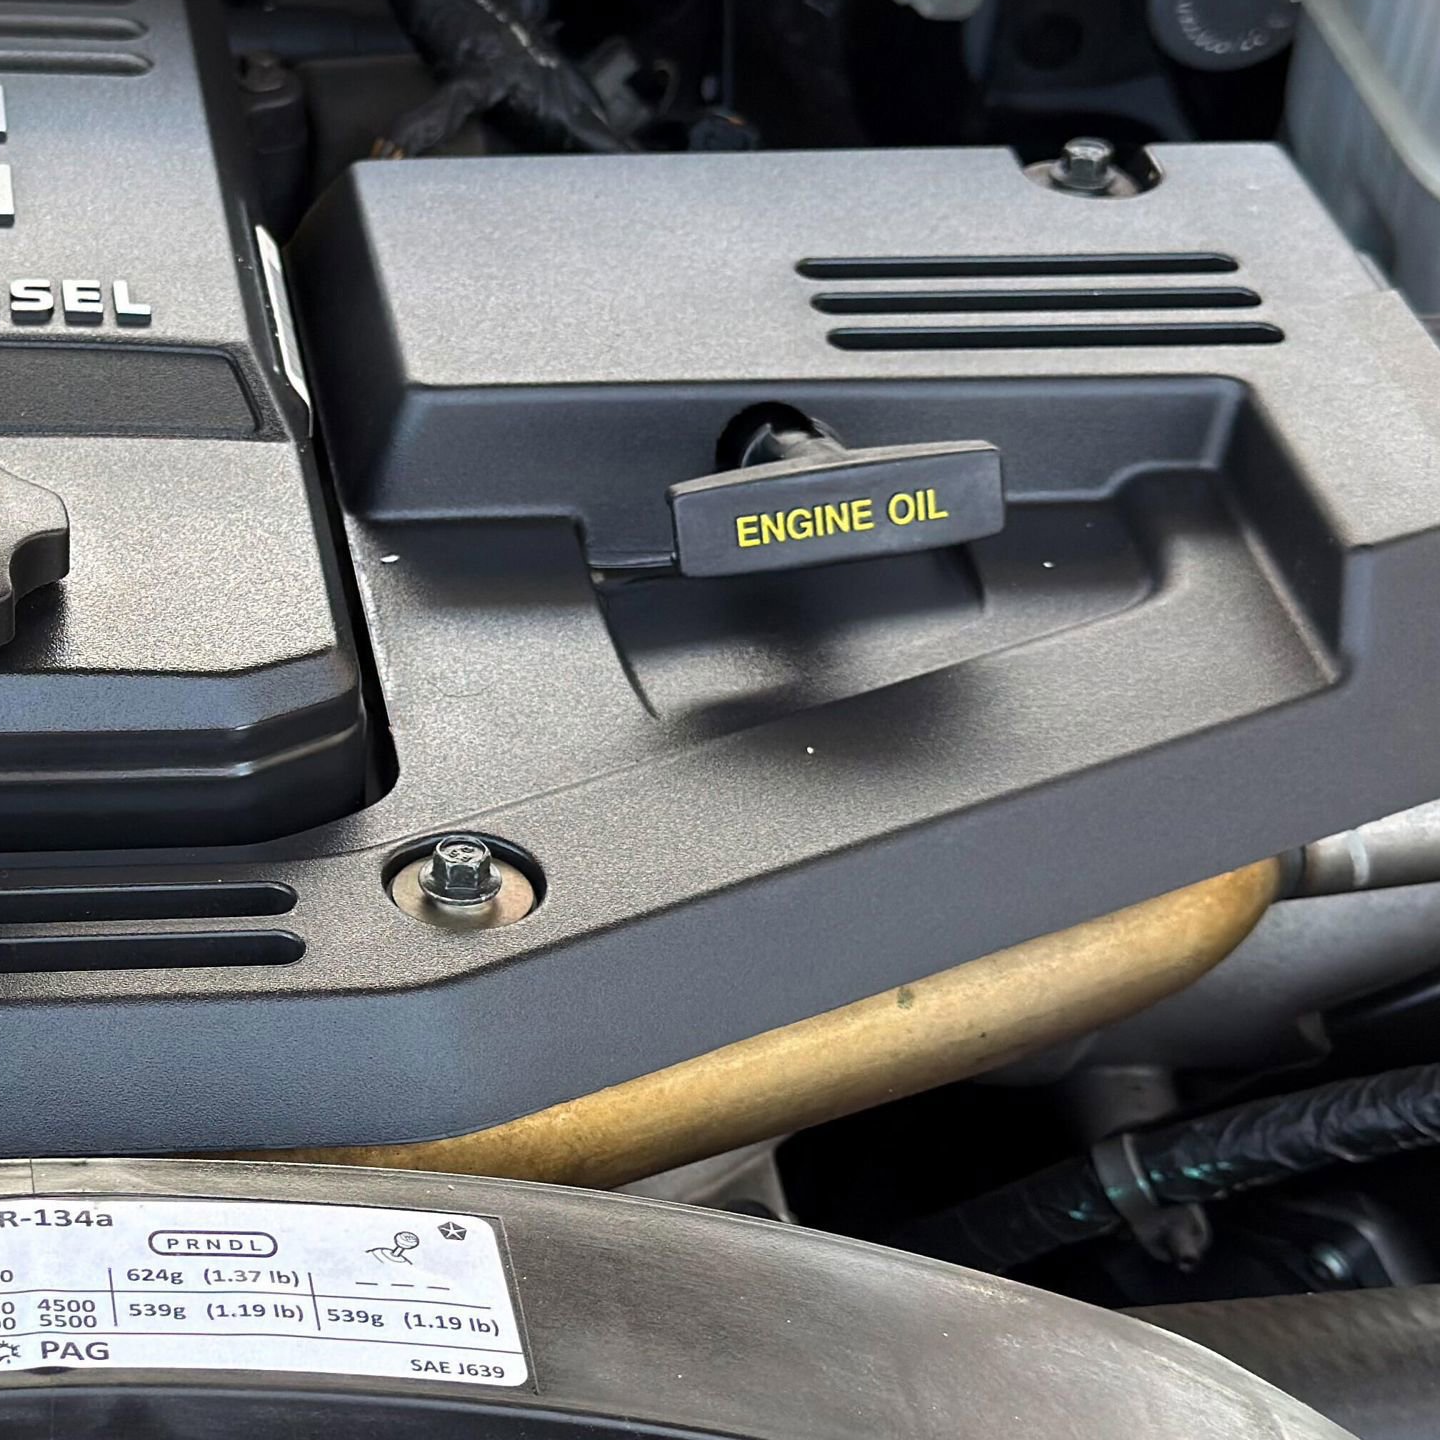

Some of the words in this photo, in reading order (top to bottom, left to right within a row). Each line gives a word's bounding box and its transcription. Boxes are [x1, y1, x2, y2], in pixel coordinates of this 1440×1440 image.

[736, 498, 875, 548] ENGINE
[888, 489, 949, 526] OIL
[126, 1268, 184, 1286] 624g
[203, 1268, 261, 1286] (1.37
[269, 1270, 300, 1288] lb)
[37, 1298, 96, 1314] 4500
[128, 1303, 187, 1320] 539g
[206, 1303, 266, 1321] (1.19
[274, 1304, 304, 1322] lb)
[327, 1308, 384, 1328] 539g
[404, 1312, 463, 1331] (1.19
[469, 1318, 500, 1337] lb)
[39, 1313, 98, 1328] 5500
[40, 1340, 110, 1361] PAG
[410, 1359, 452, 1375] SAE
[456, 1363, 506, 1379] J639
